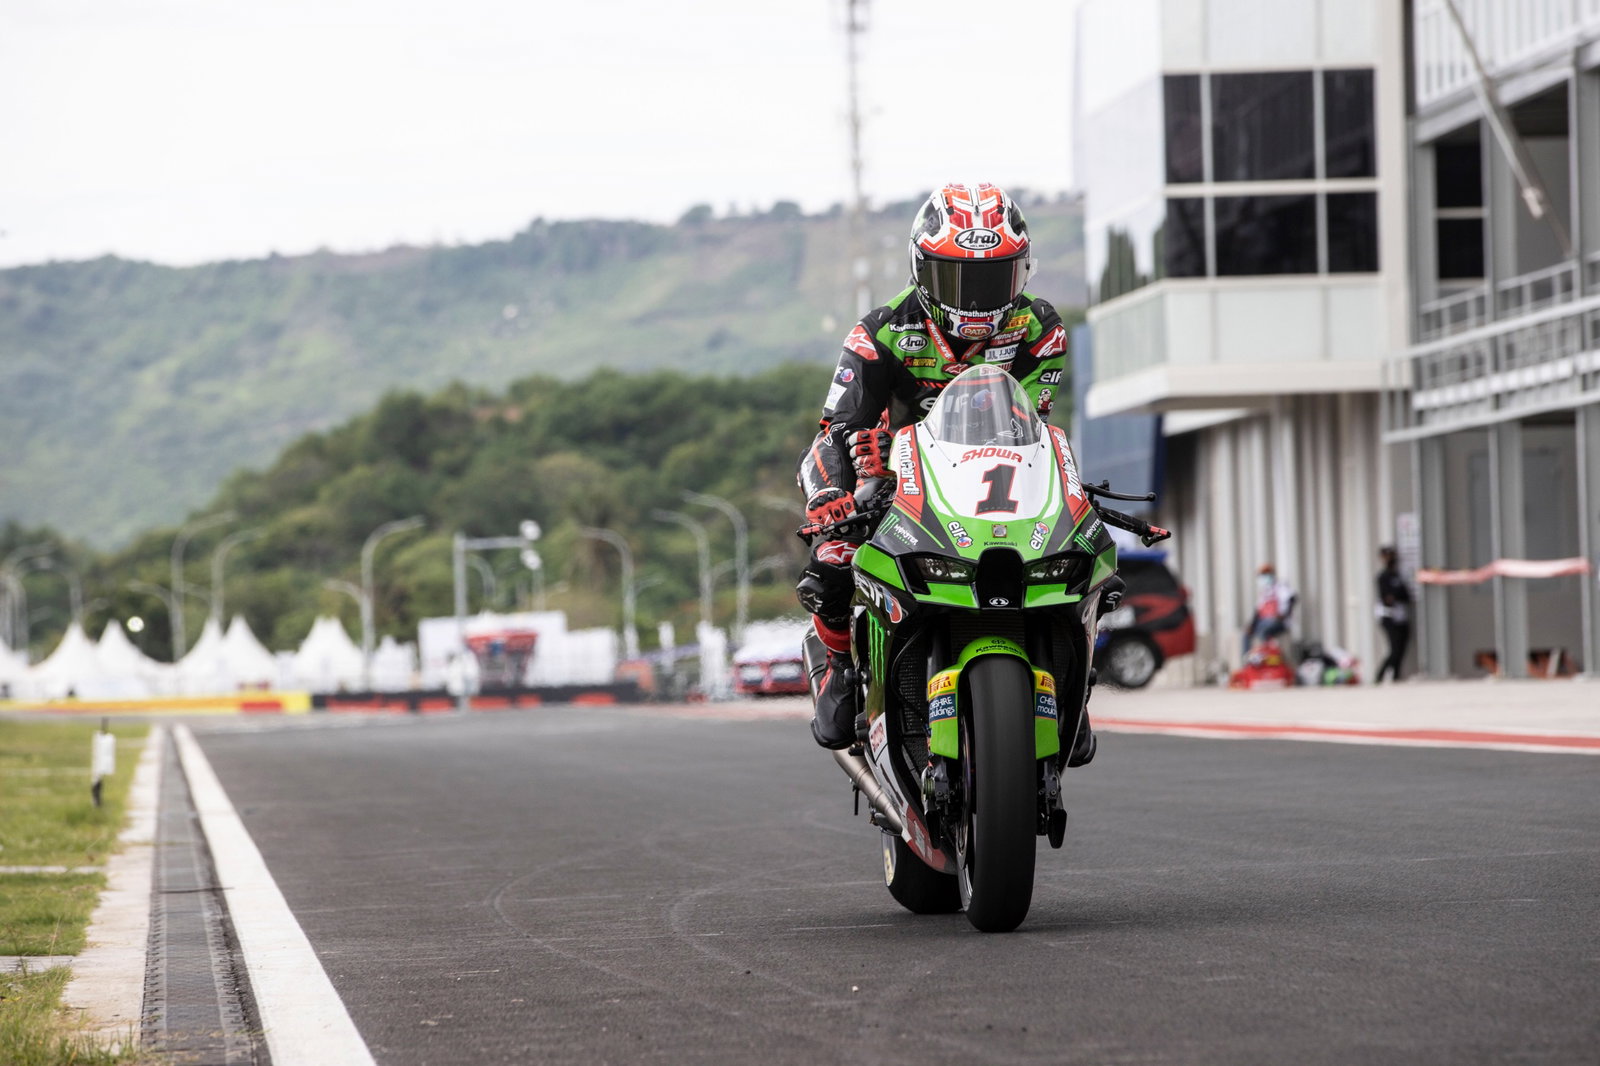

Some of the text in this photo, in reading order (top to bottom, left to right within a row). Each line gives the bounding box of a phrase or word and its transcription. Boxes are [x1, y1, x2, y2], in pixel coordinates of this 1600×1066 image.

[960, 231, 996, 245] Arai
[940, 302, 1013, 318] www.jonathan-rea.com
[889, 322, 926, 332] Kawasaki
[964, 327, 988, 335] PATA
[901, 335, 925, 348] Arai
[960, 447, 1023, 463] SHOWA
[974, 463, 1019, 517] 1
